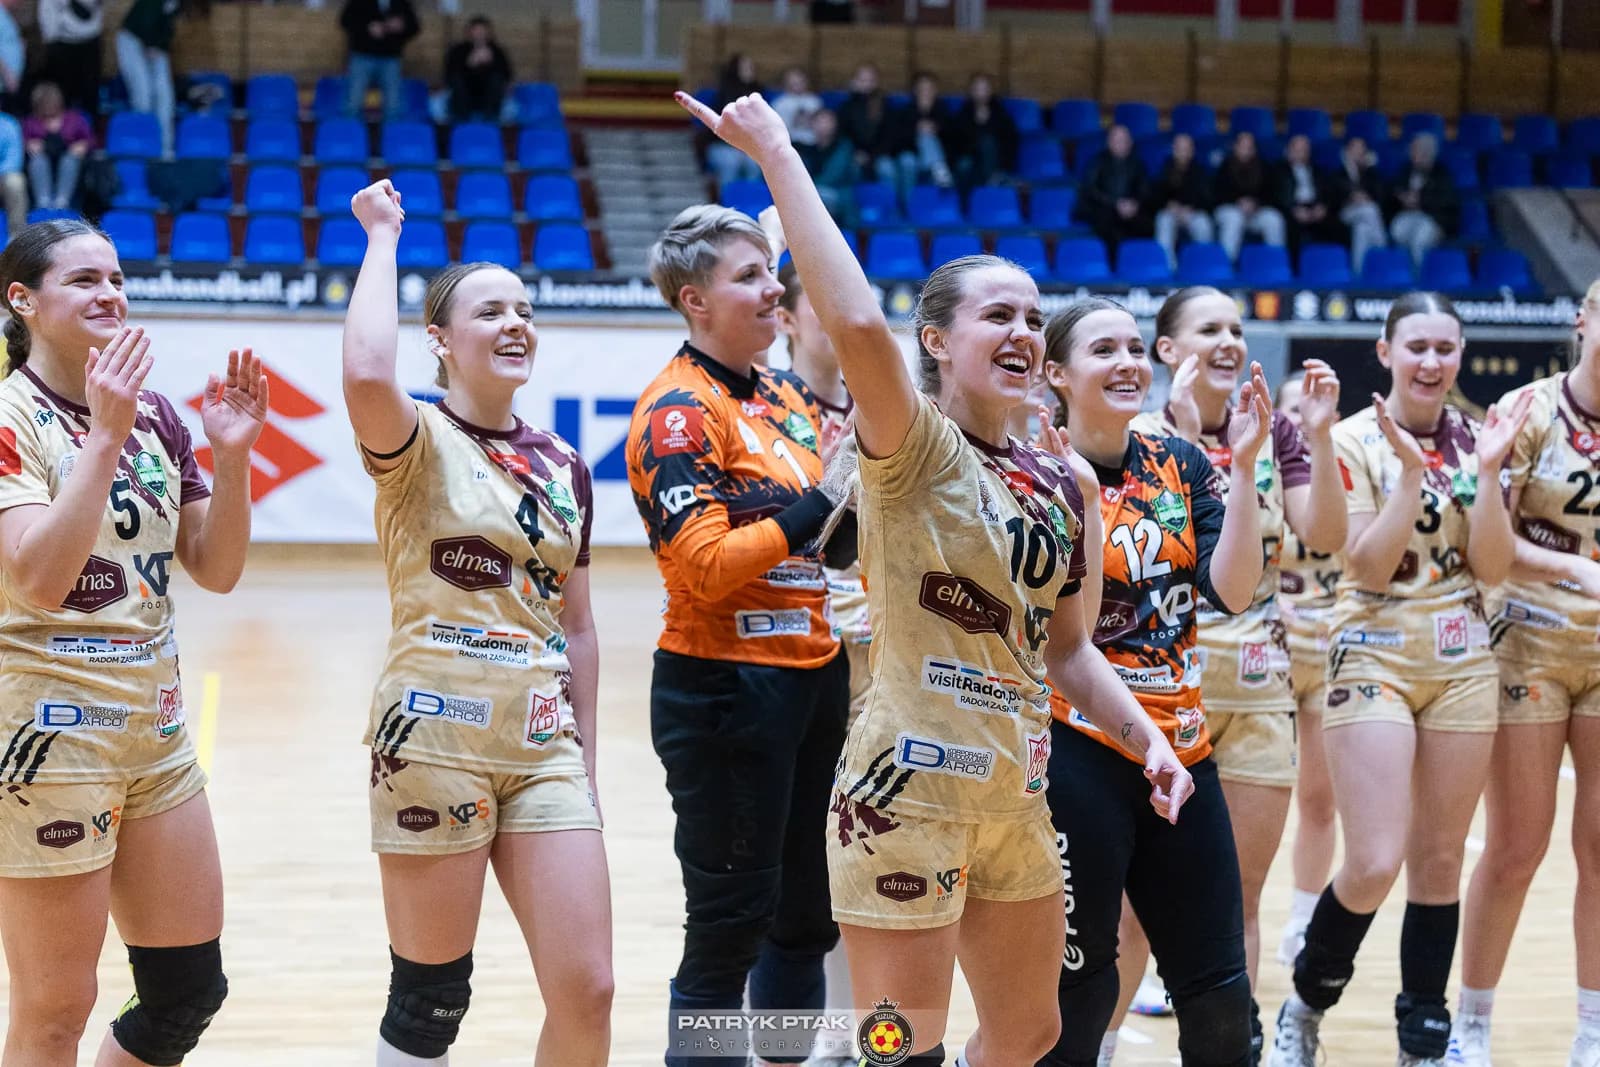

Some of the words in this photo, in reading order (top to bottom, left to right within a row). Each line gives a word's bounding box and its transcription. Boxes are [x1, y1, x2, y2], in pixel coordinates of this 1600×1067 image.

[772, 439, 810, 488] 1
[110, 478, 140, 540] 5
[515, 493, 545, 547] 4
[442, 546, 502, 575] elmas
[1006, 517, 1057, 589] 10
[1110, 518, 1172, 583] 12
[72, 573, 115, 591] mas
[432, 631, 529, 654] visitRadom.pl
[89, 656, 119, 664] RADOM
[459, 650, 488, 660] RADOM
[489, 654, 529, 665] ZASKAKUJE
[408, 692, 486, 722] DARCO
[960, 695, 989, 708] RADOM
[43, 704, 122, 727] DARCO
[902, 739, 987, 776] DARCO
[92, 806, 121, 834] KPS
[402, 811, 433, 823] elmas
[448, 799, 490, 824] KPS
[43, 825, 79, 840] elmas
[883, 878, 920, 891] elmas
[936, 864, 968, 893] KPS
